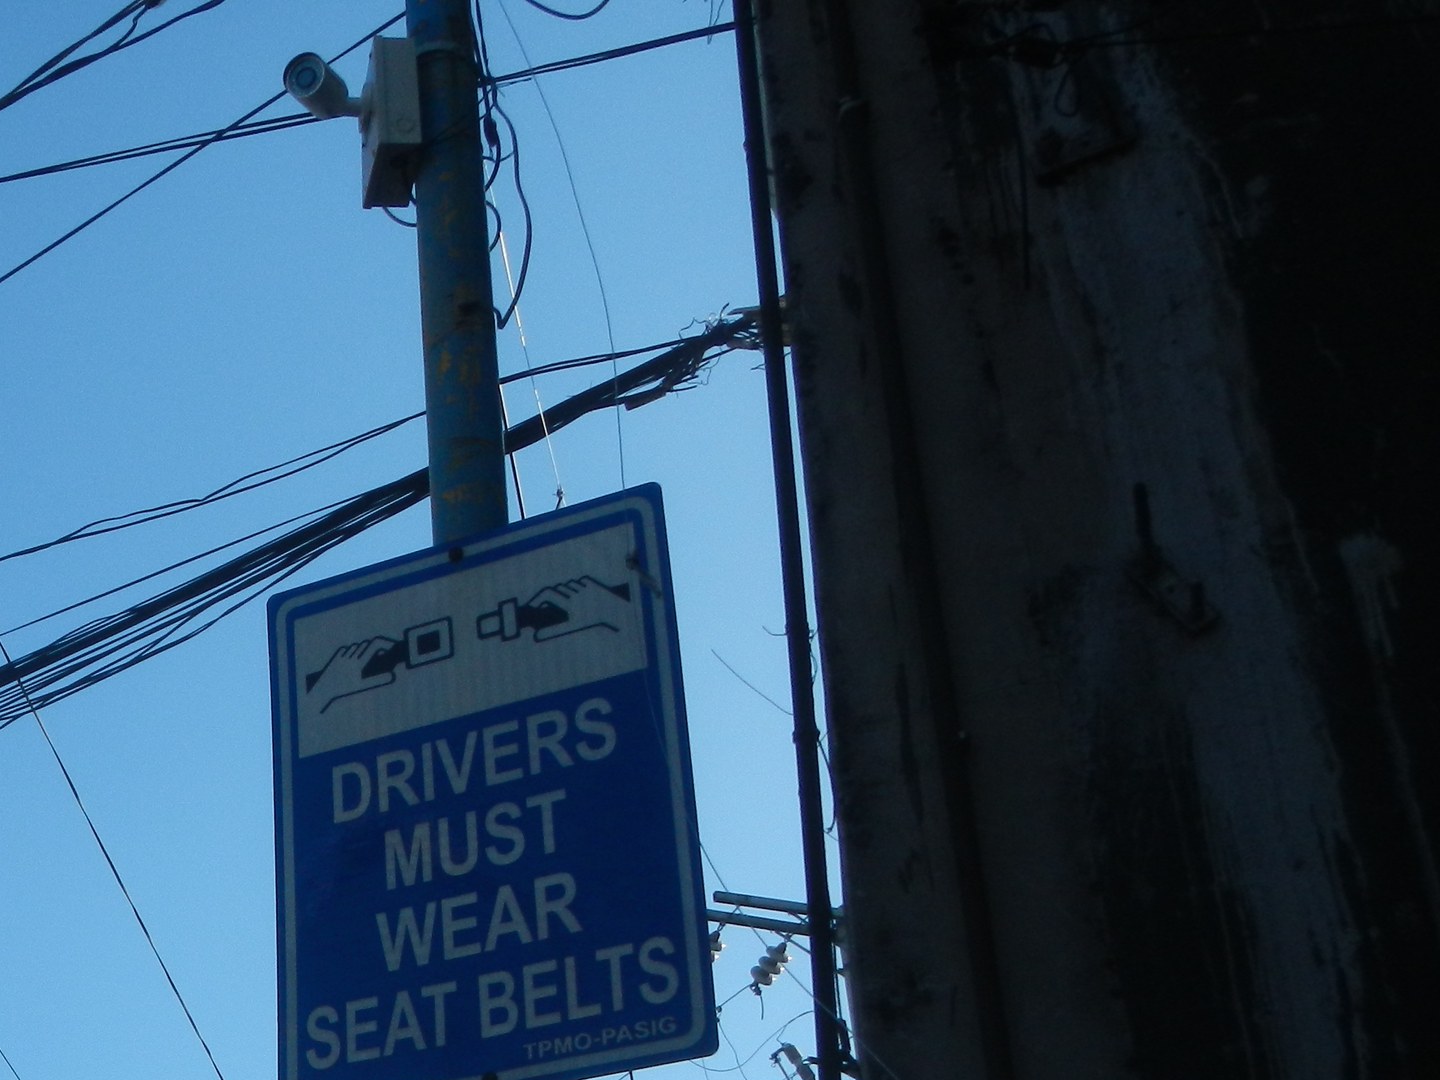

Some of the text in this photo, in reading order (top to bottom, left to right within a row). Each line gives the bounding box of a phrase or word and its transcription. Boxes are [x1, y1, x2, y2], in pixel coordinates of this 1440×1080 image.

[332, 696, 618, 824] DRIVERS
[383, 789, 567, 891] MUST
[375, 872, 583, 973] WEAR
[305, 935, 680, 1070] SEAT BELTS
[522, 1015, 678, 1060] TPMO-PASIG
